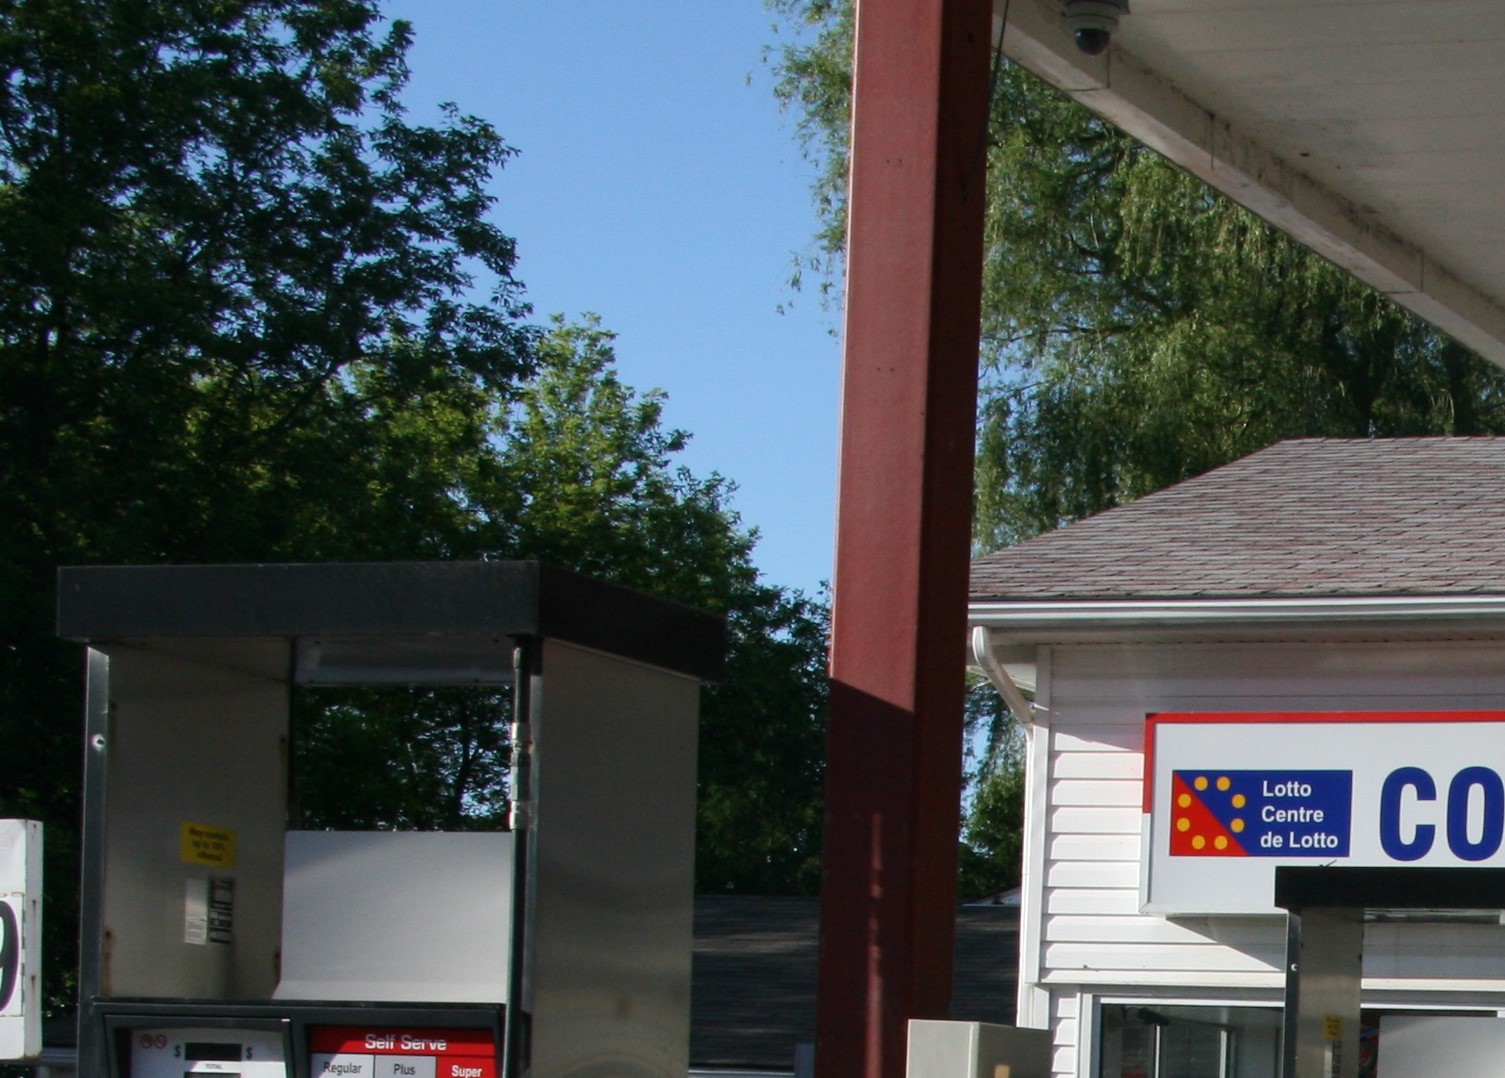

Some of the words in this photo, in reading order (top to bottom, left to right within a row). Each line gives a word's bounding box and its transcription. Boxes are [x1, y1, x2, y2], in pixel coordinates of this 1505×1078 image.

[1262, 780, 1312, 797] Lotto
[1261, 805, 1324, 822] Centre
[1260, 831, 1283, 848] de
[1289, 831, 1339, 848] Lotto
[364, 1033, 396, 1050] Self
[400, 1034, 447, 1051] Serve
[323, 1062, 362, 1077] Regular
[393, 1063, 416, 1076] Plus
